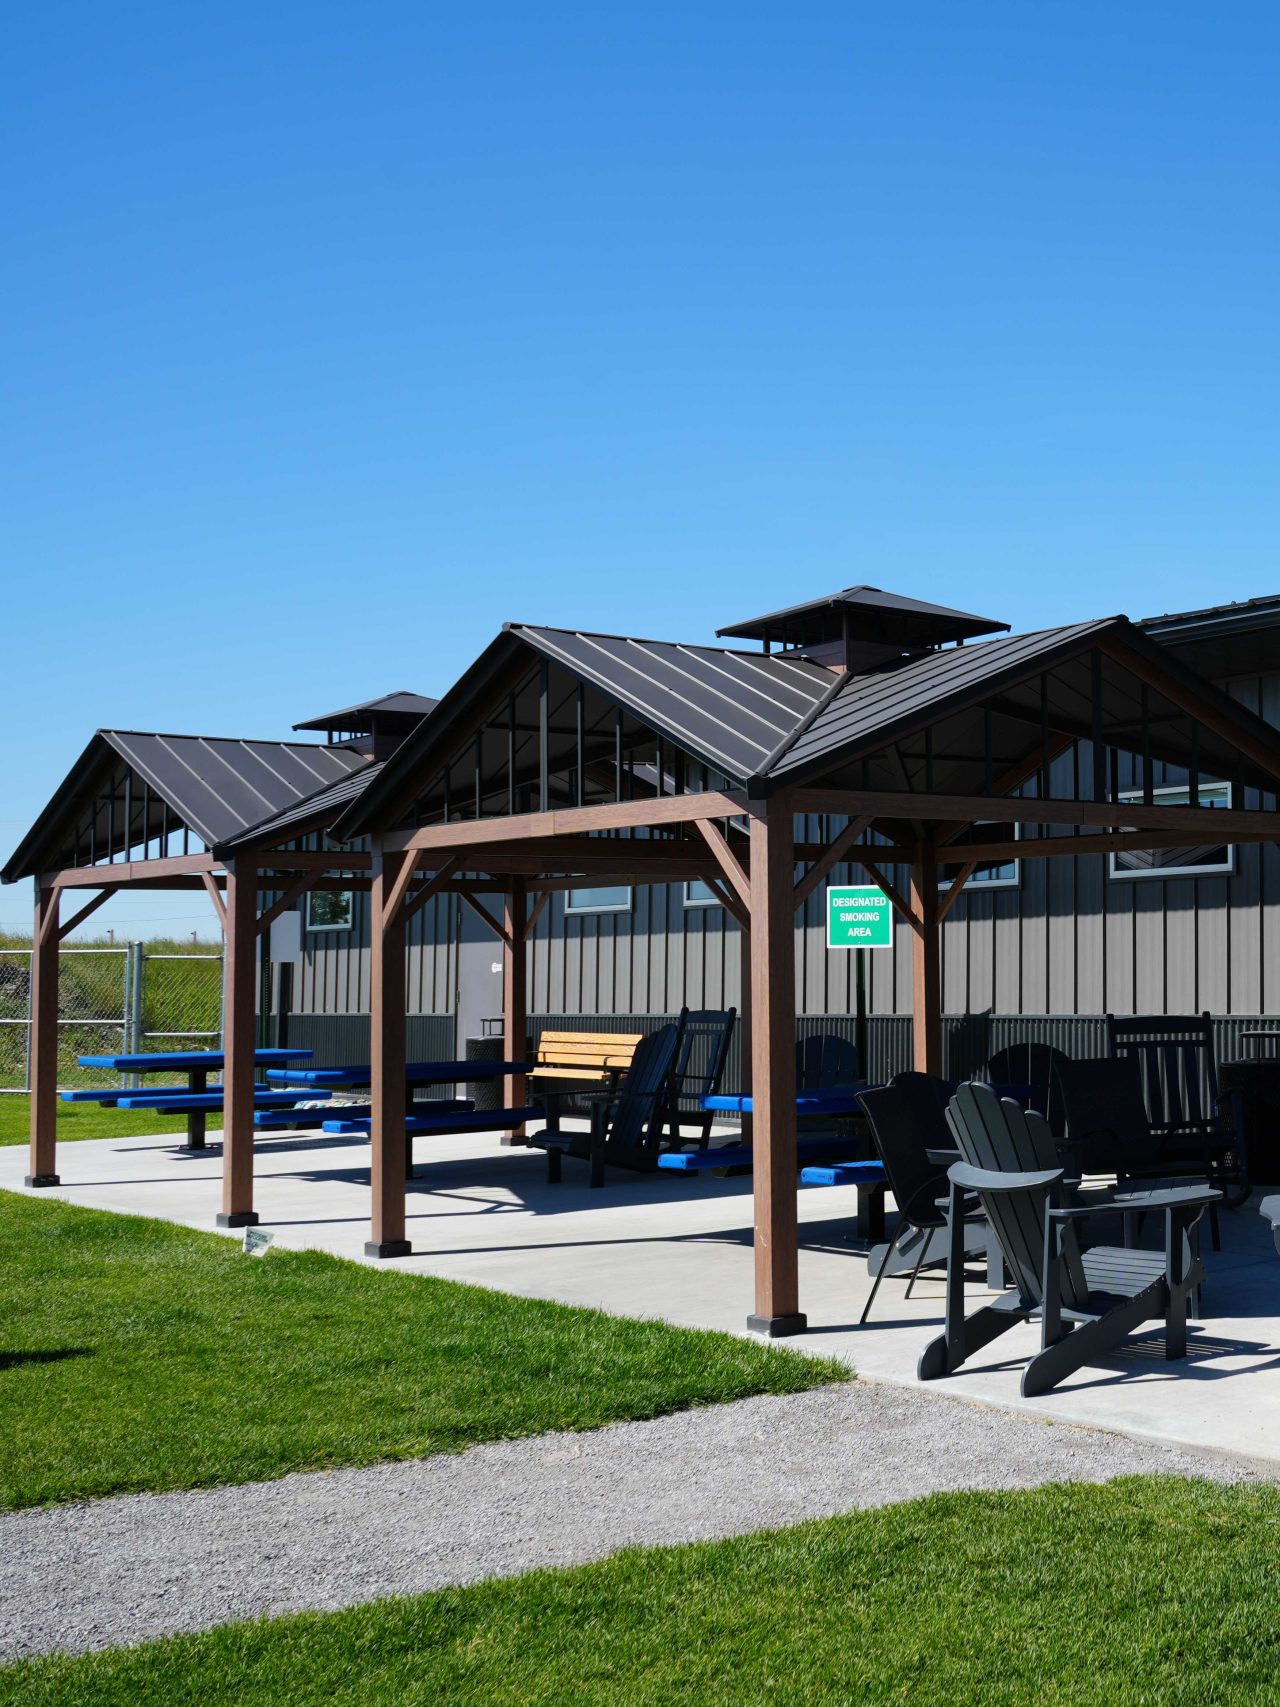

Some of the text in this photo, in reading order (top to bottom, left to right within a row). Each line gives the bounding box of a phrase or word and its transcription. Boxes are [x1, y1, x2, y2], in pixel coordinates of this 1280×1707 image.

[832, 897, 886, 907] DESIGNATED
[840, 912, 880, 922] SMOKING
[848, 927, 872, 937] AREA
